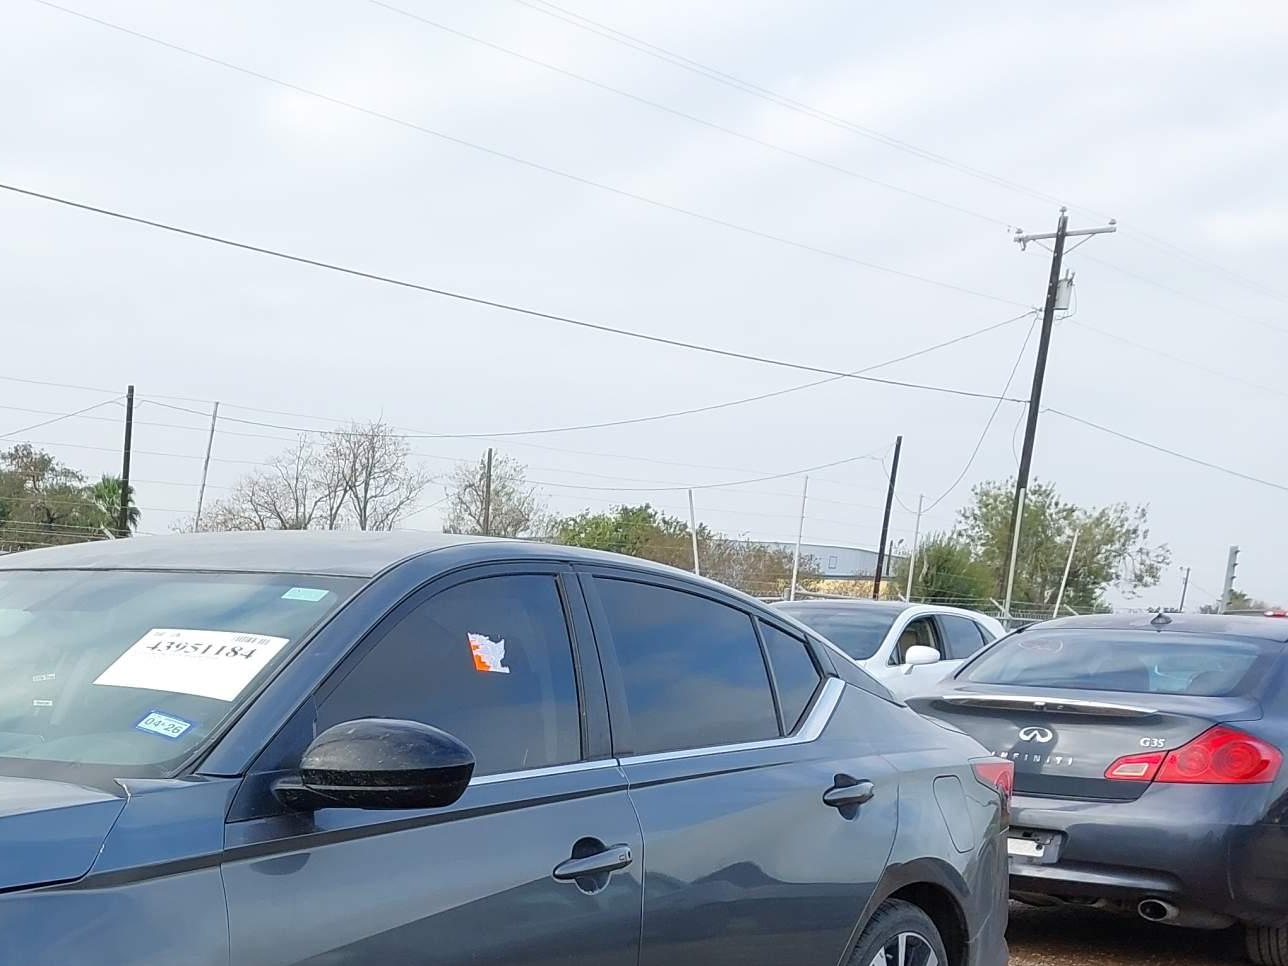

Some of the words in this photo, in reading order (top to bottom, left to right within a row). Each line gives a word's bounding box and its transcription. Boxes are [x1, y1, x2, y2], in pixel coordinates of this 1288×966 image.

[146, 641, 257, 659] 43951184
[1139, 737, 1166, 747] G35
[991, 751, 1073, 766] INFINITI
